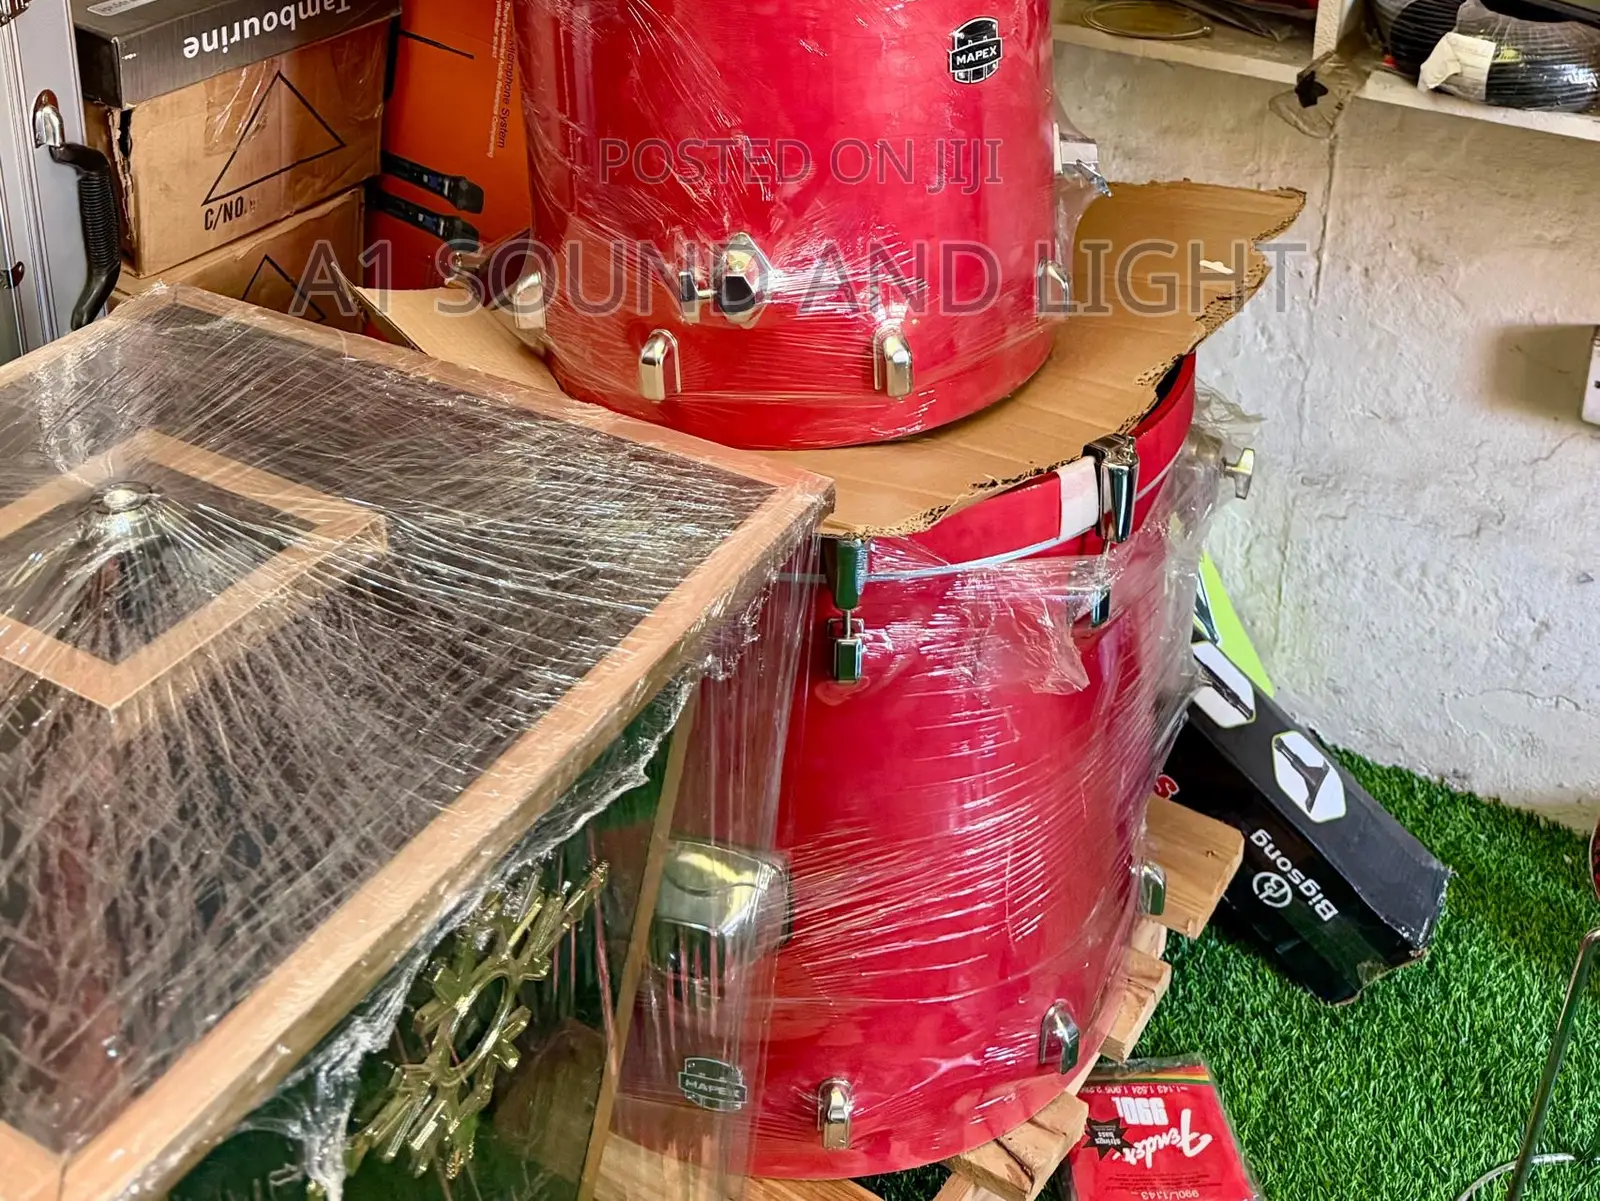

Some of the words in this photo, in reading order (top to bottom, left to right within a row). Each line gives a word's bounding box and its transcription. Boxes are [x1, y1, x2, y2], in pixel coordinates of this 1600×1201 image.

[503, 40, 516, 105] Microphone
[955, 44, 998, 66] MAPEX
[498, 108, 510, 148] System
[1250, 828, 1339, 922] Bigsong
[1111, 1096, 1169, 1125] 990L
[1123, 1108, 1213, 1169] Fender
